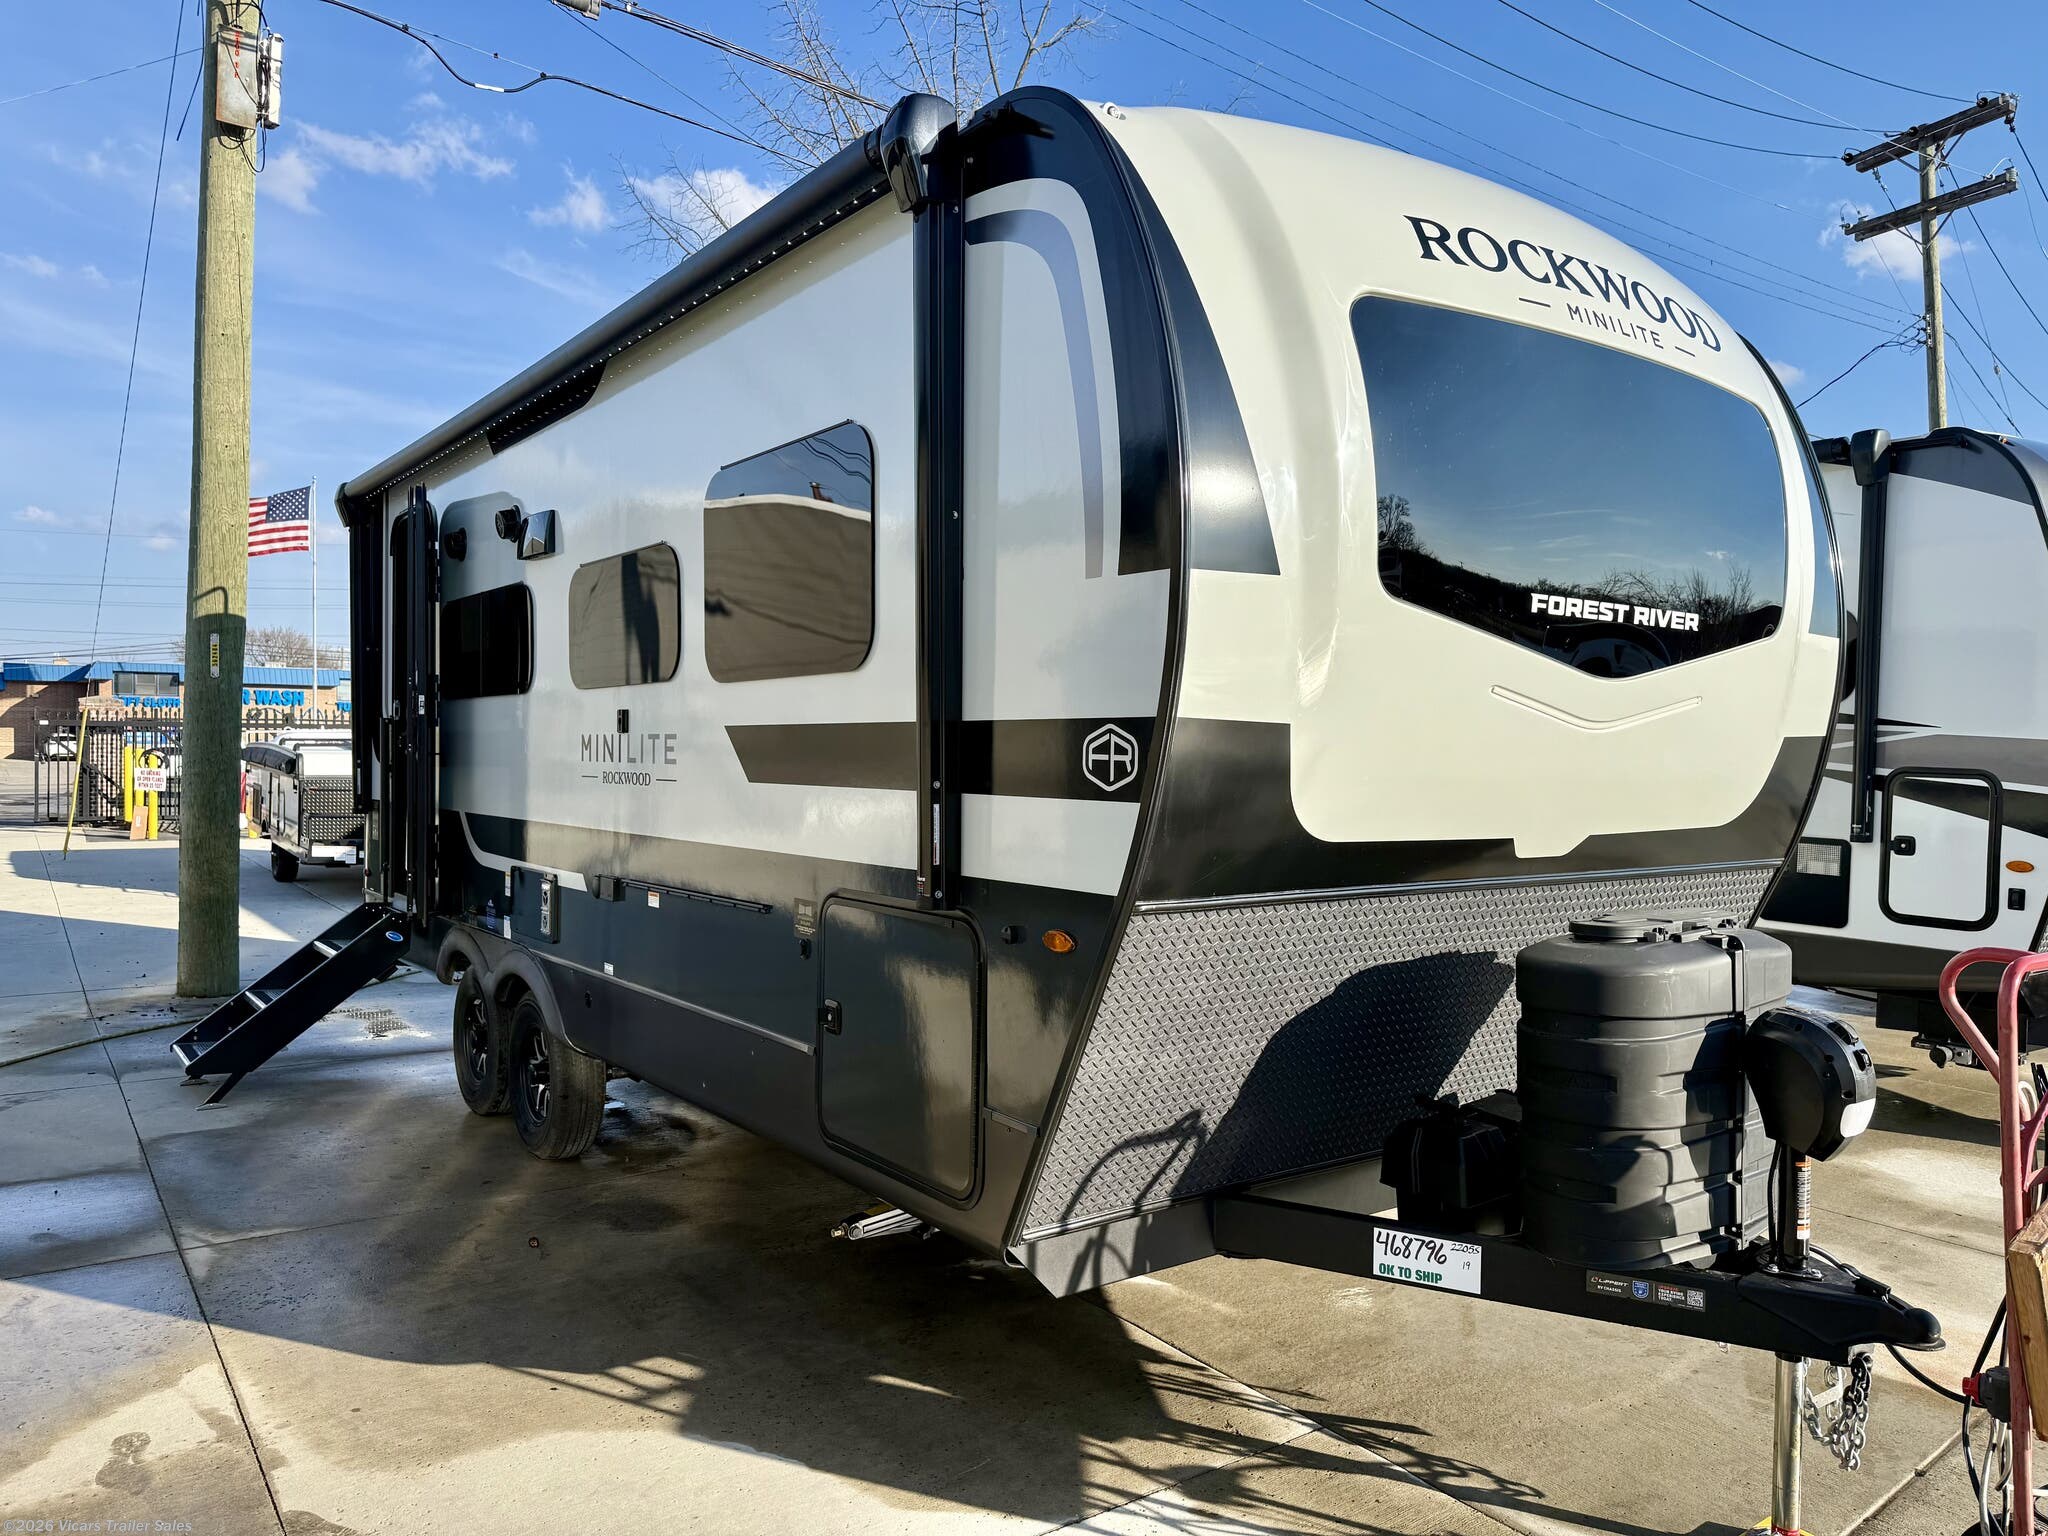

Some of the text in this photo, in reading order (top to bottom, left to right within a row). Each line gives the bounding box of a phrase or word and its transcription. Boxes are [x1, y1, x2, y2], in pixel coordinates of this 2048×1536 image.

[1402, 215, 1722, 352] ROCKWOOD
[1566, 302, 1664, 349] MINILITE
[1530, 592, 1700, 632] FOREST RIVER
[254, 690, 304, 706] WASH
[581, 733, 677, 765] MINILITE
[602, 771, 652, 787] ROCKWOOD
[1376, 1230, 1448, 1265] 468796
[1378, 1263, 1443, 1284] OK TO SHIP
[1462, 1261, 1471, 1271] 19
